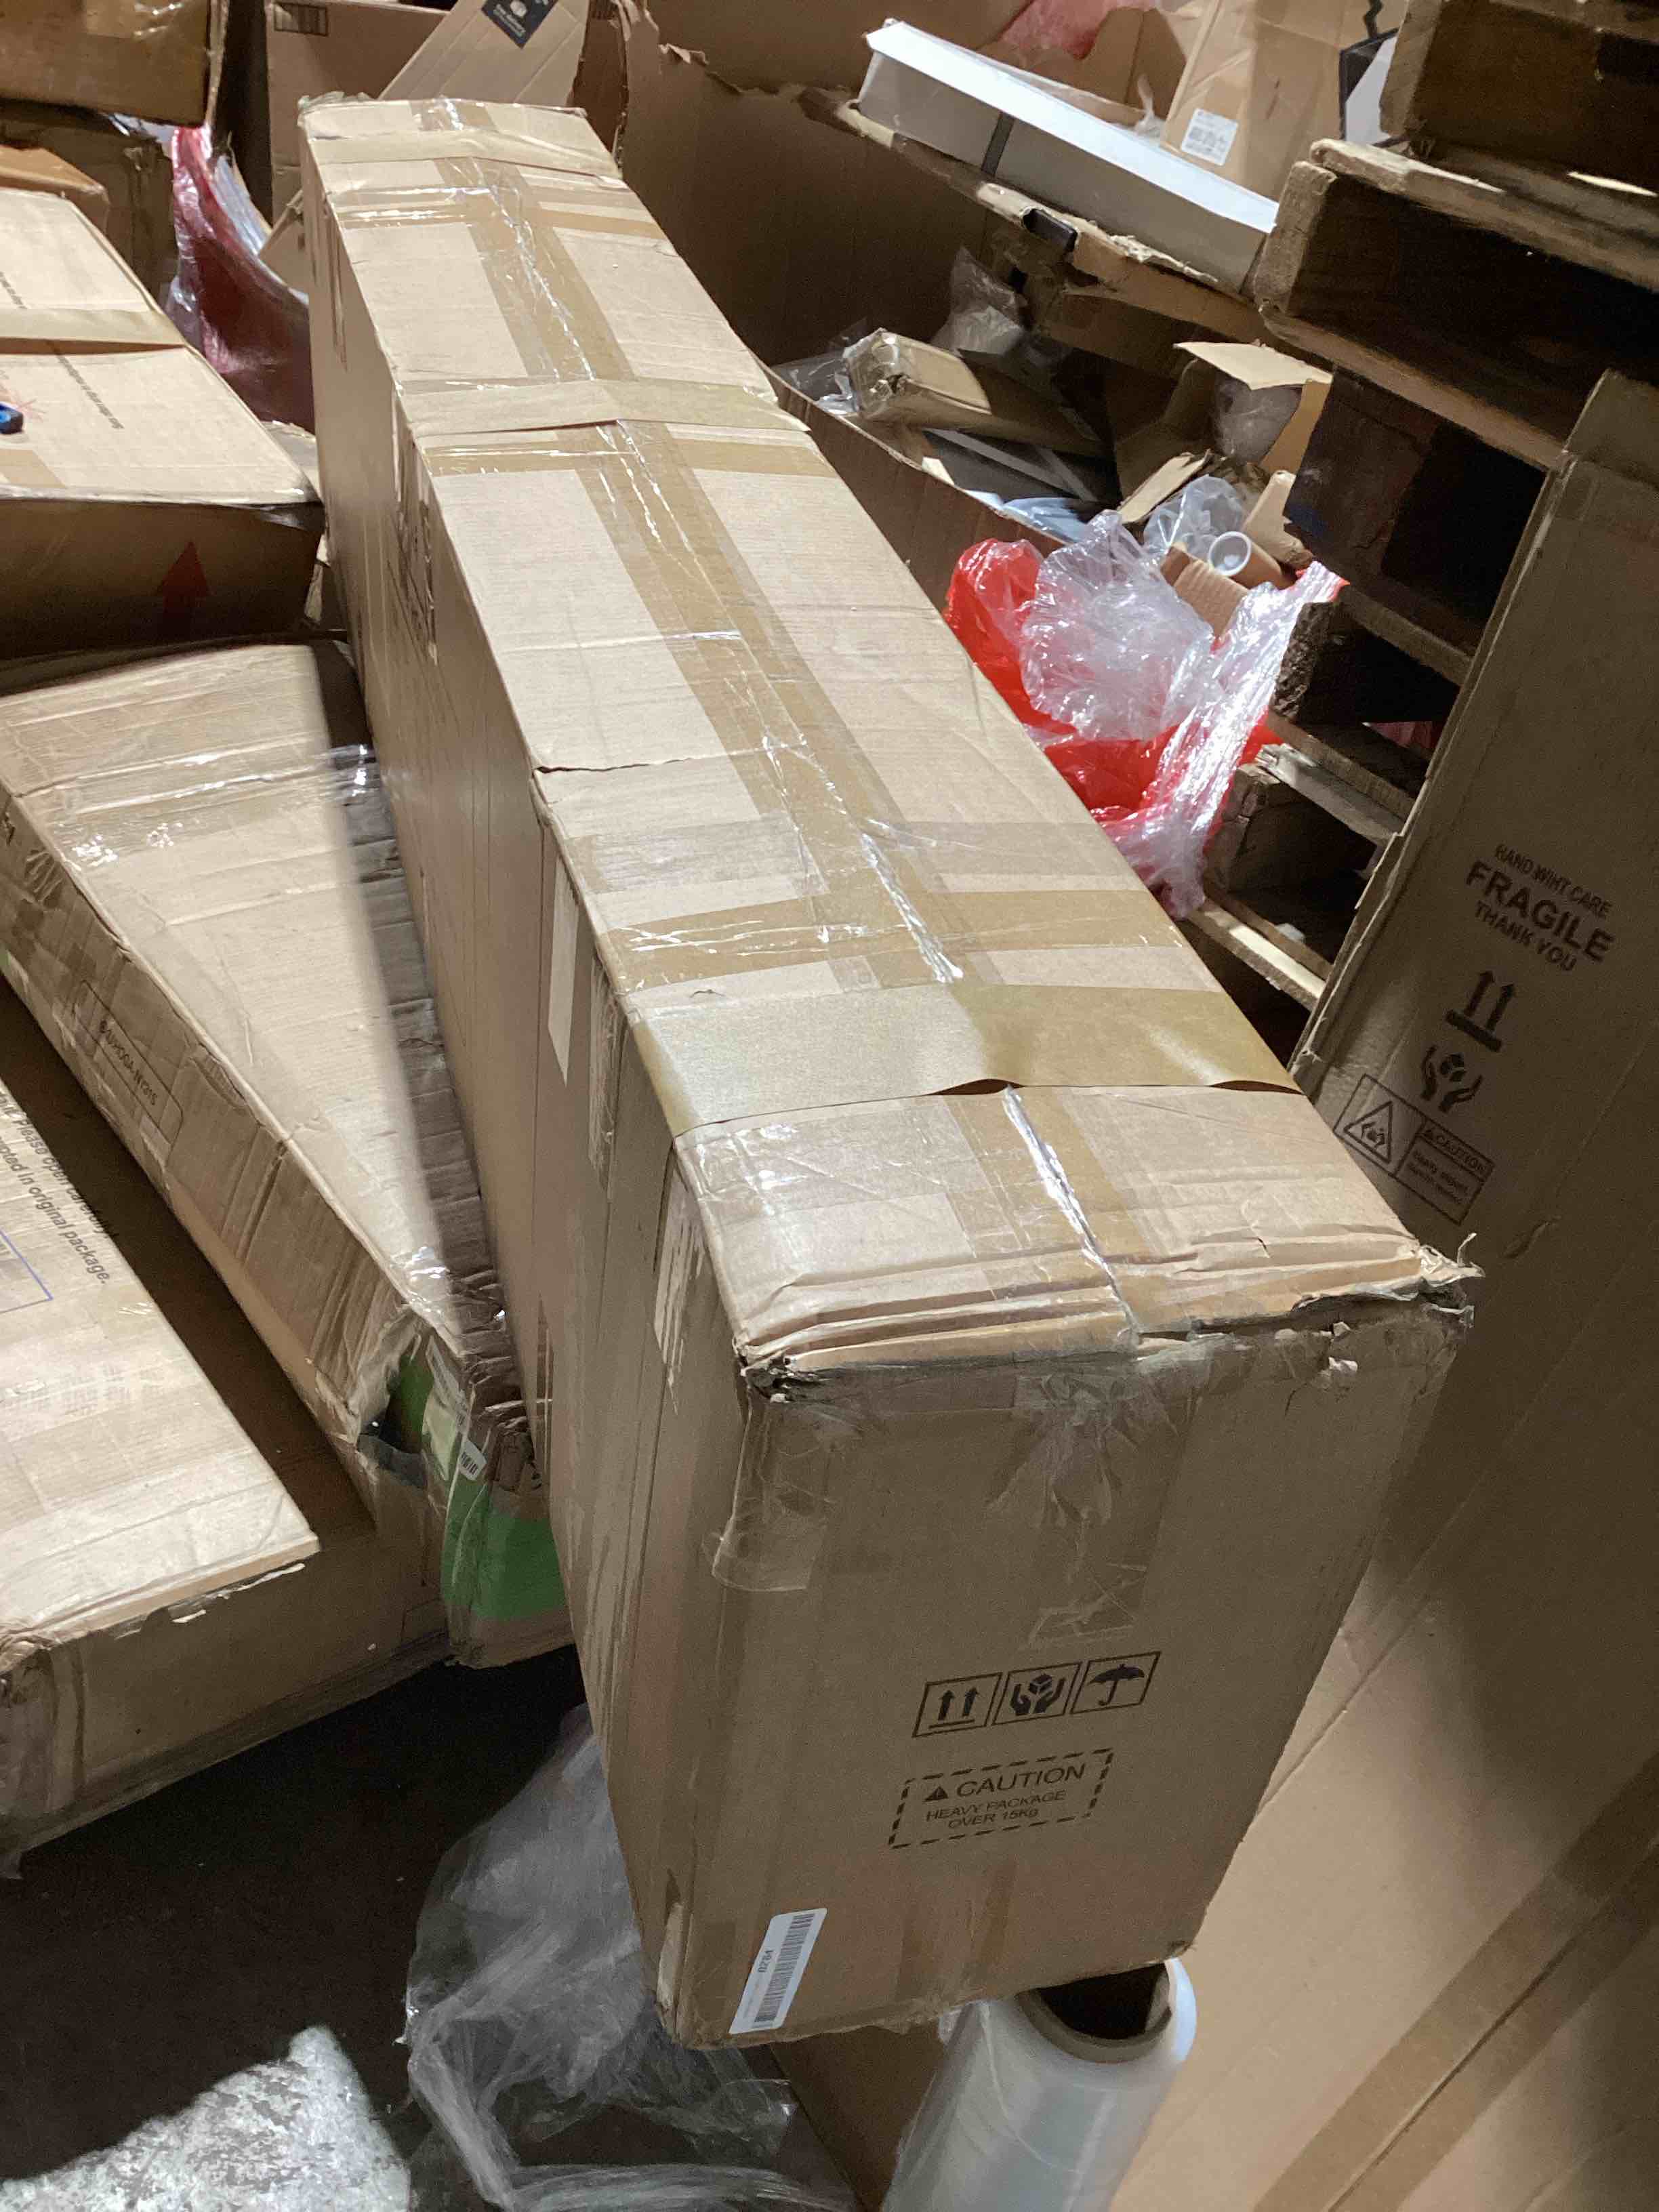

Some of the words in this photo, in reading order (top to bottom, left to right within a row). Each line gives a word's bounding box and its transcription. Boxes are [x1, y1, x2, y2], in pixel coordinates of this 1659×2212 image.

[1495, 844, 1534, 874] HAND
[1570, 886, 1613, 918] CARE
[1466, 860, 1614, 963] FRAGILE
[1475, 900, 1534, 945] THANK
[1538, 939, 1576, 970] YOU
[42, 1156, 70, 1185] open
[29, 1186, 74, 1229] original
[59, 1228, 110, 1284] package.
[926, 1803, 983, 1822] HEAVY
[986, 1790, 1066, 1811] PACKAGE
[956, 1763, 1086, 1797] CAUTION
[949, 1814, 997, 1828] OVER
